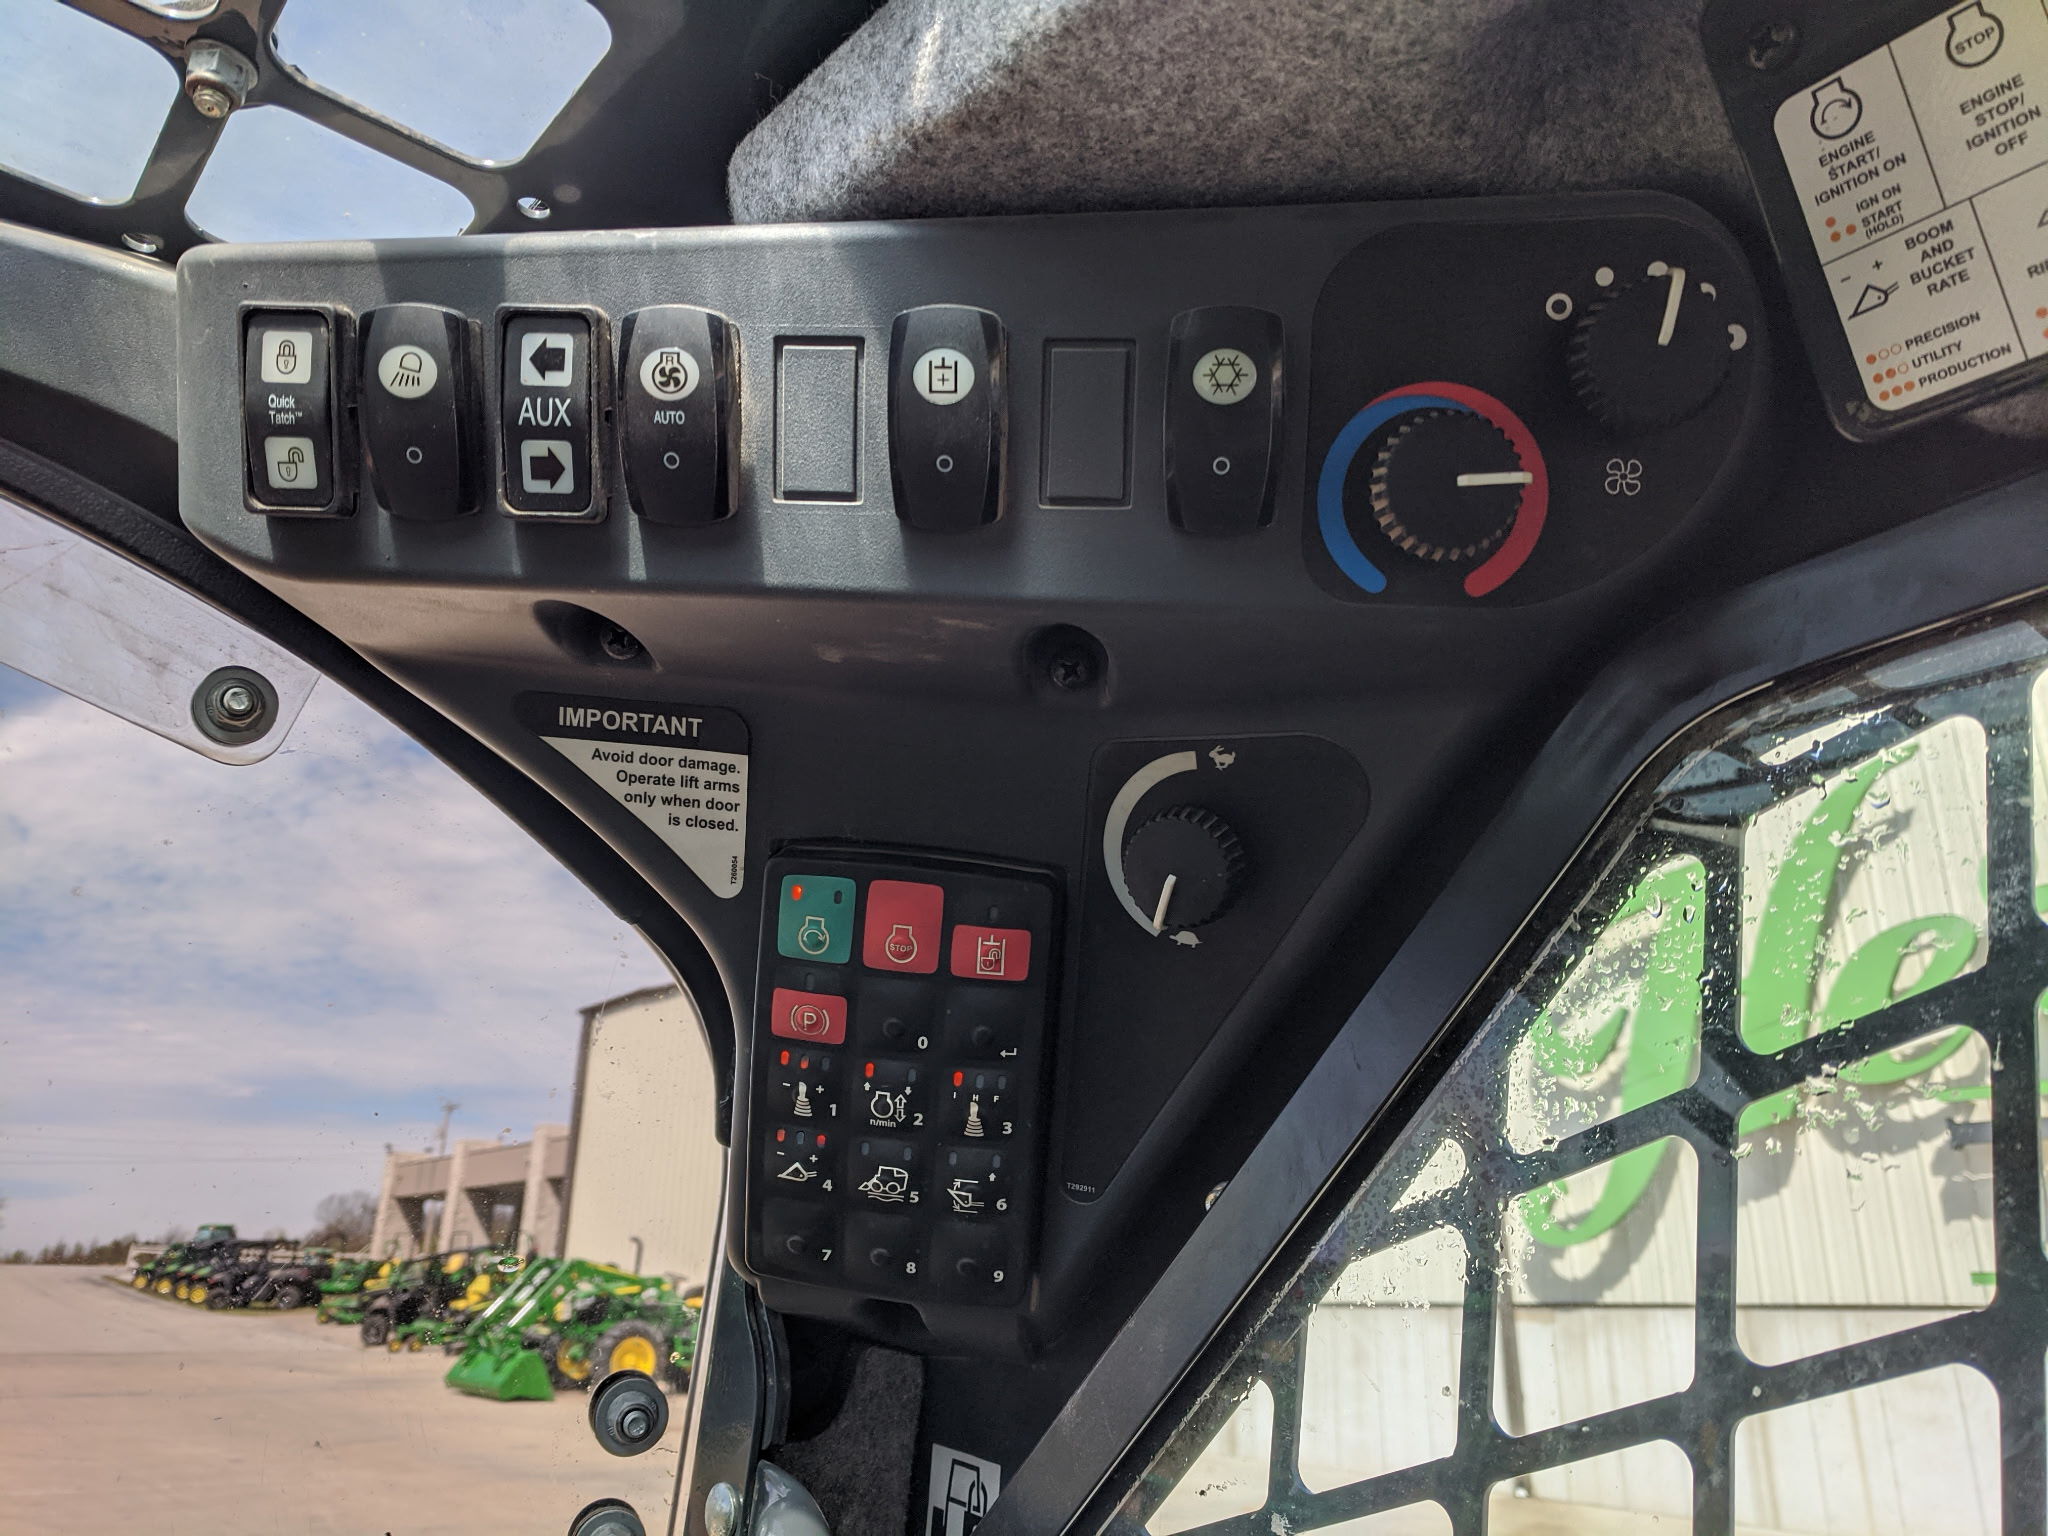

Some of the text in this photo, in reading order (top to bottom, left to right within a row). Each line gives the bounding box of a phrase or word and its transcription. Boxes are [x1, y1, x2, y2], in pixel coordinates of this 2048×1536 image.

[1954, 26, 1995, 55] STOP
[1959, 73, 2025, 115] ENGINE
[1974, 92, 2025, 127] STOP/
[1966, 105, 2042, 151] IGNITION
[1818, 130, 1876, 168] ENGINE
[1994, 131, 2029, 156] OFF
[1828, 145, 1880, 181] START/
[1814, 152, 1907, 207] IGNITION ON
[1856, 183, 1902, 213] IGN ON
[1861, 200, 1902, 228] START
[1865, 214, 1904, 240] (HOLD)
[1904, 219, 1954, 250] BOOM
[1921, 239, 1954, 263] AND
[1909, 247, 1975, 285] BUCKET
[1926, 268, 1971, 297] RATE
[1905, 311, 1981, 351] PRECISION
[1911, 340, 1963, 369] UTILITY
[1918, 343, 2013, 388] PRODUCTION
[268, 393, 296, 409] Quick
[518, 397, 572, 427] AUX
[653, 410, 686, 425] AUTO
[558, 705, 703, 738] IMPORTANT
[591, 748, 741, 776] Avoid door damage.
[616, 769, 741, 793] Operate lift arms
[623, 792, 741, 813] only when door
[668, 813, 739, 832] is closed.
[889, 943, 913, 953] STOP
[803, 1011, 817, 1030] P
[917, 1036, 928, 1050] 0
[829, 1104, 837, 1117] 1
[869, 1118, 897, 1128] n/min
[913, 1113, 923, 1126] 2
[1002, 1122, 1013, 1135] 3
[822, 1179, 833, 1192] 4
[909, 1191, 919, 1203] 5
[996, 1199, 1007, 1211] 6
[822, 1249, 832, 1261] 7
[906, 1262, 917, 1275] 8
[993, 1270, 1004, 1283] 9
